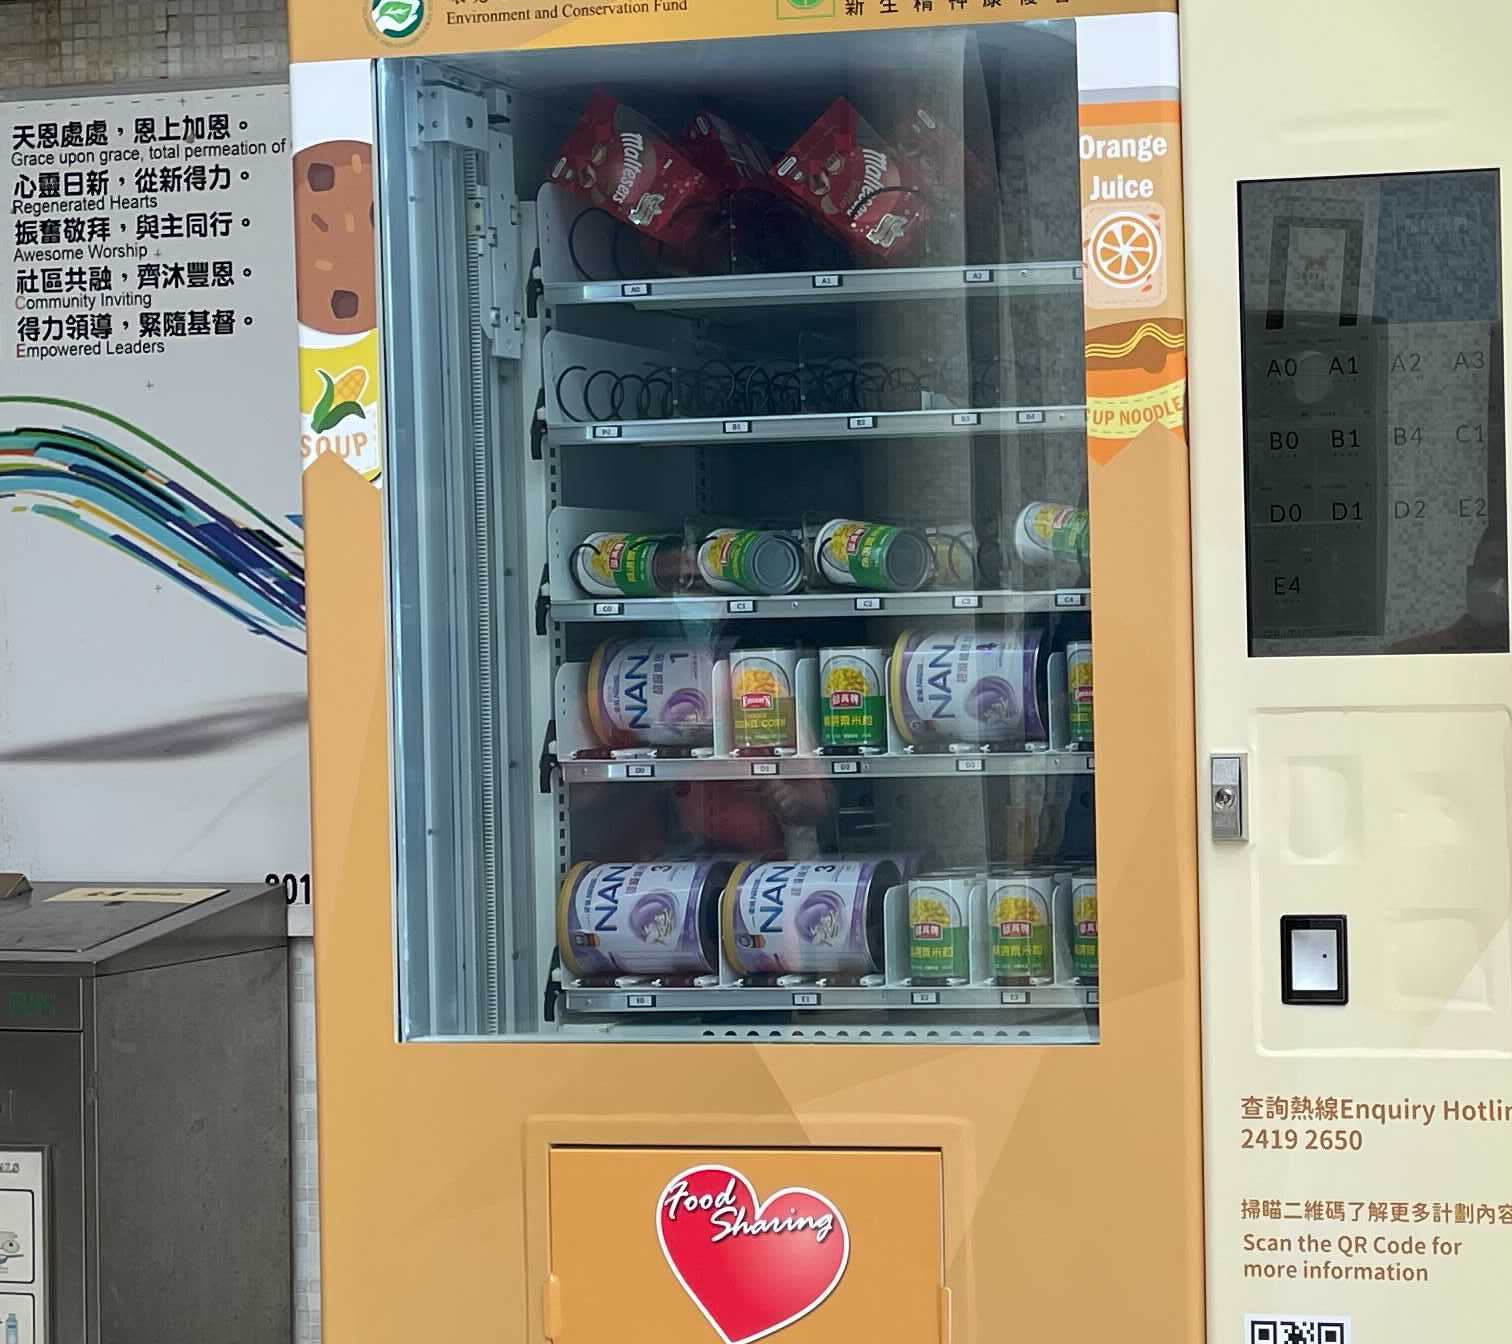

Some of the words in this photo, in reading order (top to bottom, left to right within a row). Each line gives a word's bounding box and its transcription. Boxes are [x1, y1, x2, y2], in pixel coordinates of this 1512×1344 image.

[446, 8, 531, 25] Environment
[534, 4, 559, 20] and
[562, 0, 650, 19] Conservation
[11, 151, 55, 167] Grace
[59, 153, 95, 166] upon
[100, 150, 145, 166] grace,
[149, 144, 180, 159] total
[184, 141, 267, 159] permeation
[271, 138, 287, 153] of
[1079, 133, 1168, 163] Orange
[612, 132, 644, 204] Maltesers
[1089, 174, 1154, 201] Juice
[12, 196, 105, 217] Regenerated
[110, 194, 158, 210] Hearts
[13, 245, 84, 262] Awesome
[88, 243, 148, 261] Worship
[15, 294, 96, 313] Community
[101, 292, 152, 309] Inviting
[16, 340, 101, 360] Empowered
[106, 338, 165, 356] Leaders
[1454, 349, 1485, 370] A3
[1266, 358, 1298, 378] A0
[1328, 356, 1360, 376] A1
[1390, 353, 1422, 373] A2
[1269, 431, 1299, 451] B0
[1331, 429, 1360, 449] B1
[1394, 426, 1424, 446] B4
[1456, 424, 1486, 444] C1
[1270, 503, 1302, 524] D0
[1332, 502, 1363, 522] D1
[1395, 499, 1426, 519] D2
[1459, 497, 1487, 518] E2
[1273, 576, 1302, 596] E4
[624, 655, 650, 729] NAN
[928, 643, 956, 720] NAN
[595, 864, 635, 932] NAN
[760, 864, 797, 934] NAN
[1241, 1128, 1298, 1149] 2419
[1304, 1129, 1363, 1151] 2650
[664, 1177, 736, 1220] Food
[710, 1206, 833, 1243] Sharing
[1243, 1233, 1292, 1252] Scan
[1298, 1234, 1332, 1253] the
[1337, 1236, 1367, 1257] QR
[1373, 1236, 1426, 1255] Code
[1432, 1237, 1462, 1256] for
[1243, 1262, 1297, 1279] more
[1303, 1260, 1429, 1282] information
